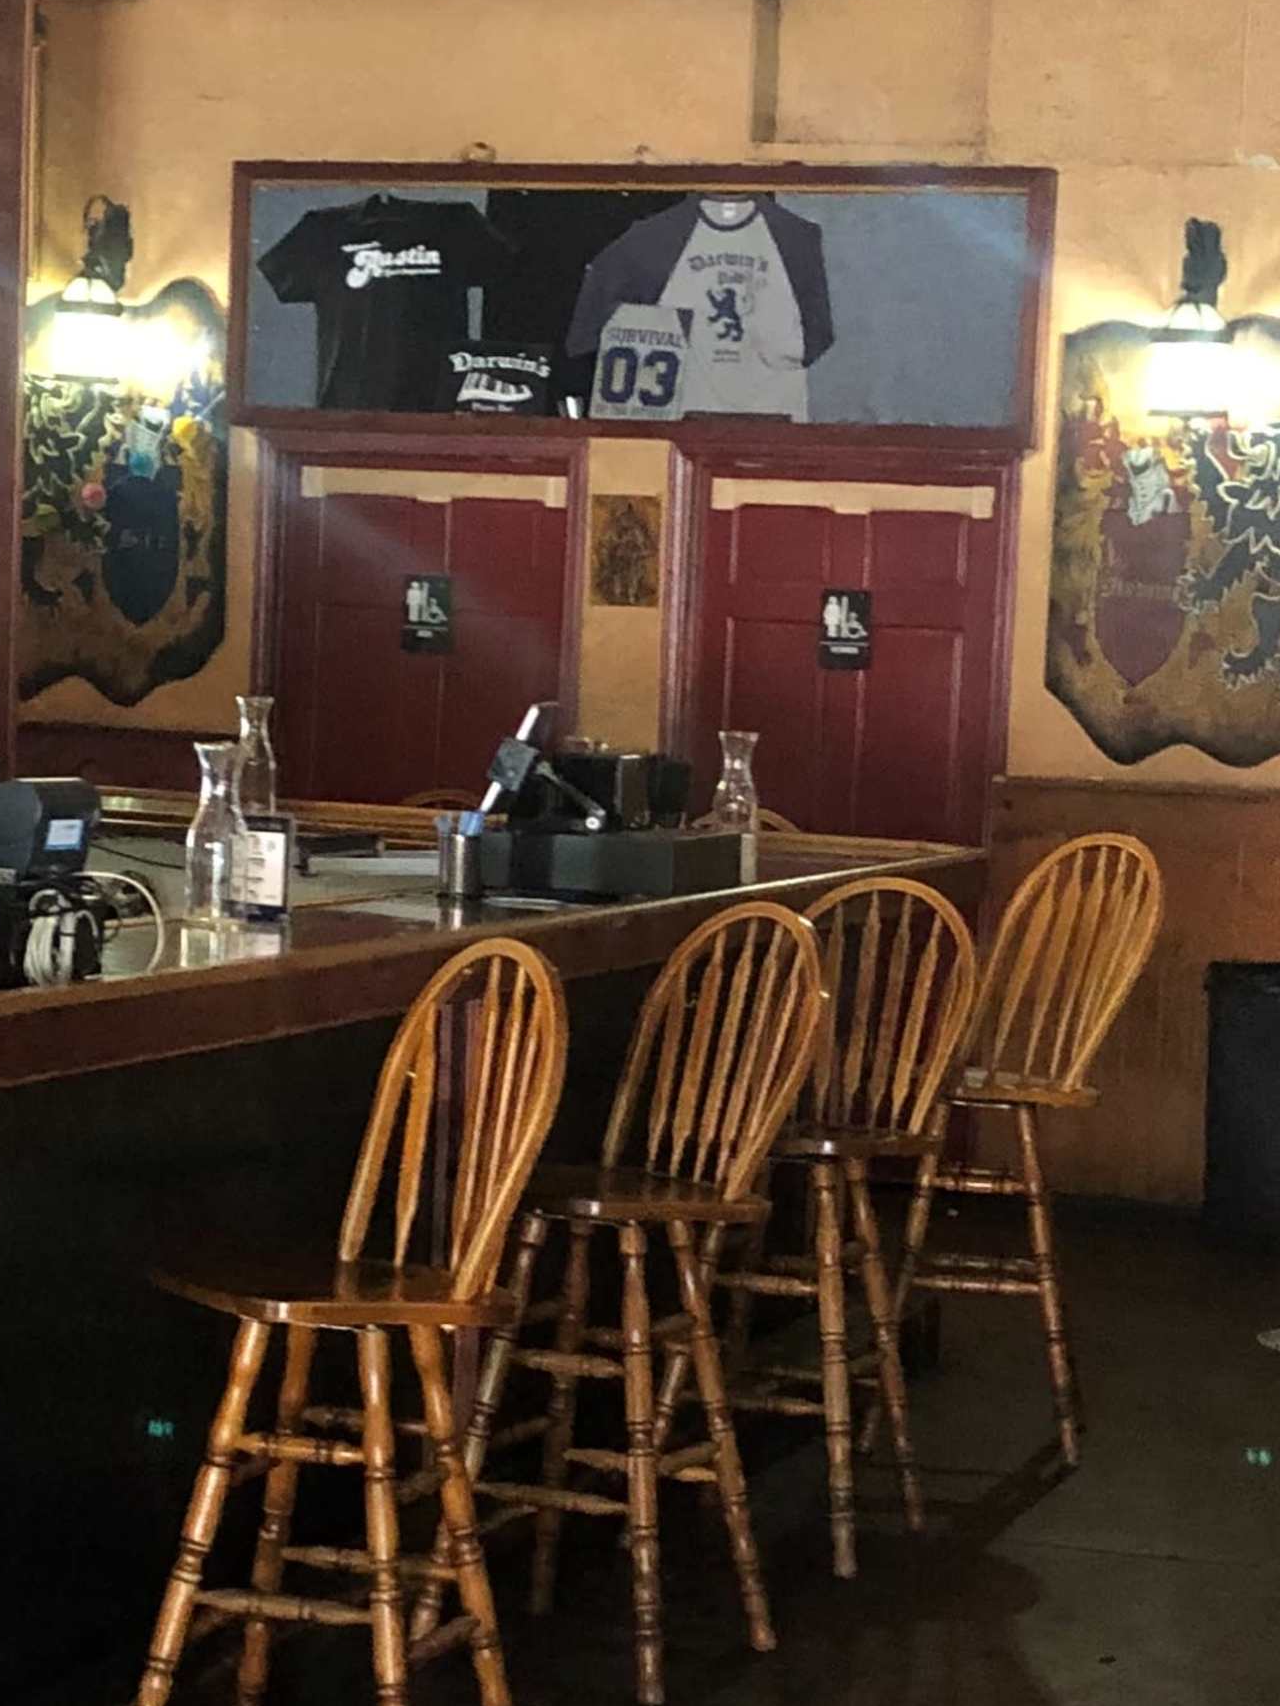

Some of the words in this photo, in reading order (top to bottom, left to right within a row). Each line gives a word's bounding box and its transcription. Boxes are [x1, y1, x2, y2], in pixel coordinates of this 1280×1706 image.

[346, 244, 441, 289] Austin
[448, 352, 551, 378] Darwin's
[599, 346, 681, 407] 03
